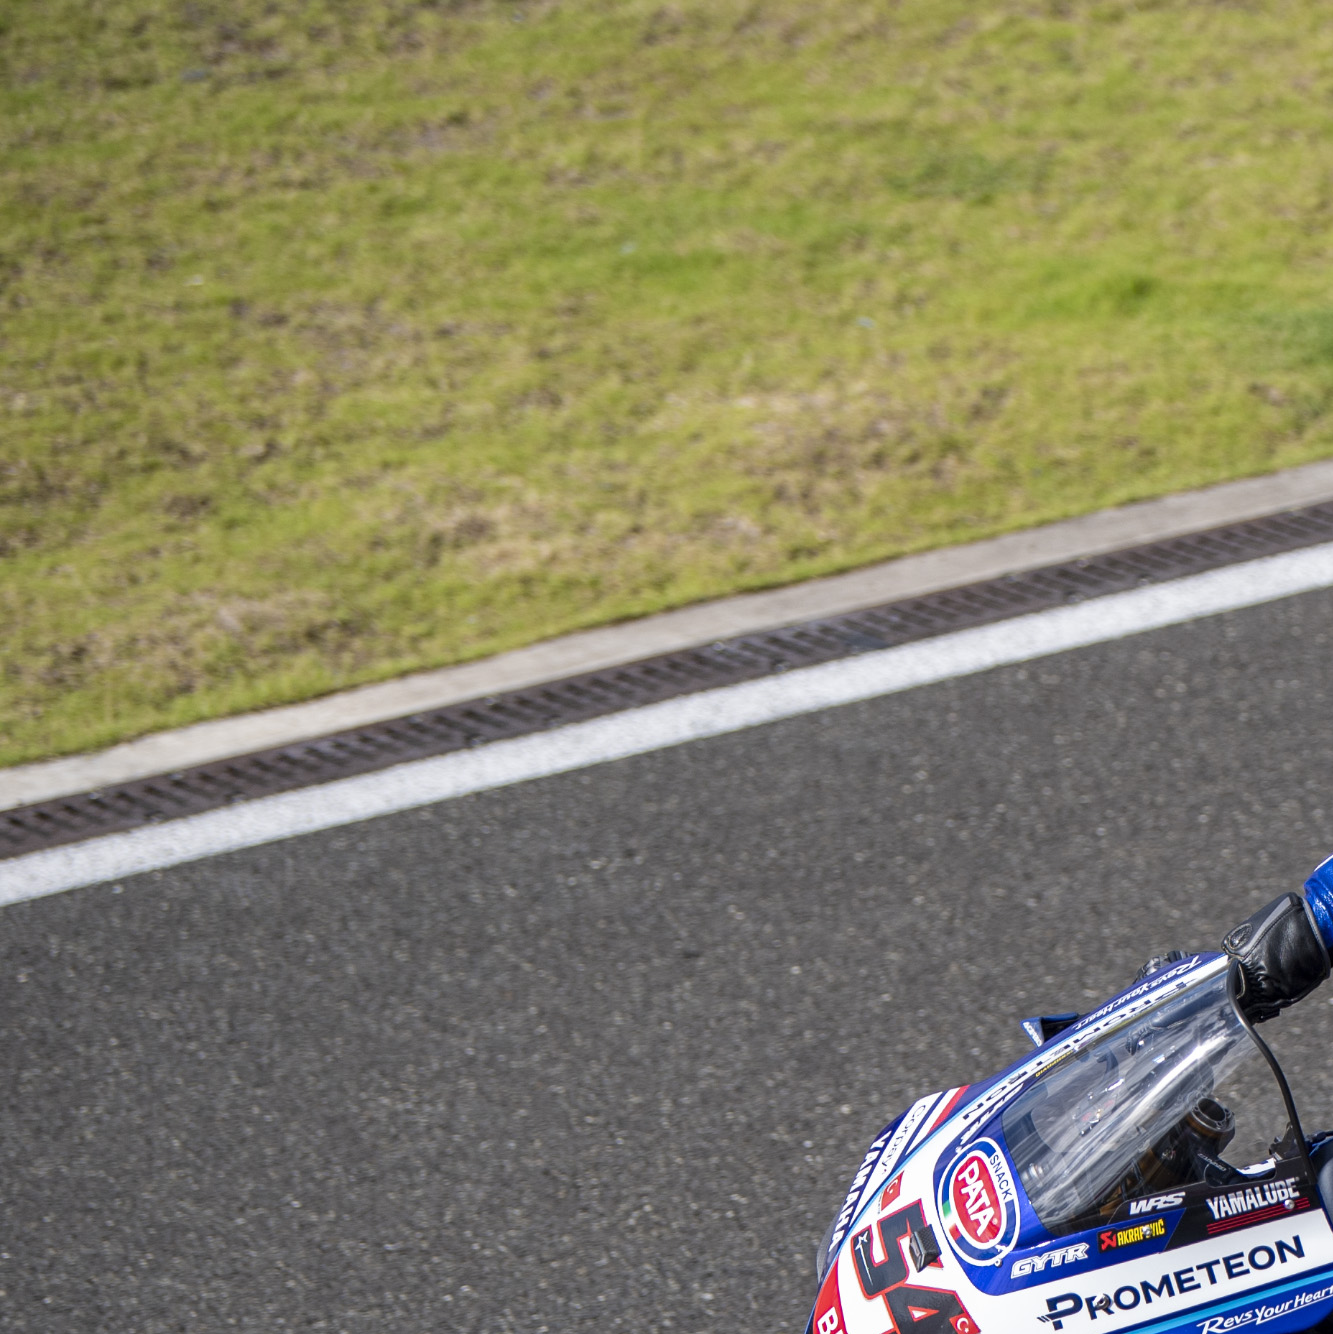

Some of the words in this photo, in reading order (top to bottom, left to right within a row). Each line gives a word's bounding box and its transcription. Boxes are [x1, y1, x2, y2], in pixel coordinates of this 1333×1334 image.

[828, 1130, 893, 1252] YAMAHA
[957, 1160, 995, 1237] PATA
[990, 1154, 1013, 1201] SNACK
[1206, 1178, 1300, 1221] YAMALUBE
[1129, 1191, 1186, 1216] WRS
[1011, 1242, 1090, 1279] GYTR
[1038, 1234, 1306, 1332] PROMETEON
